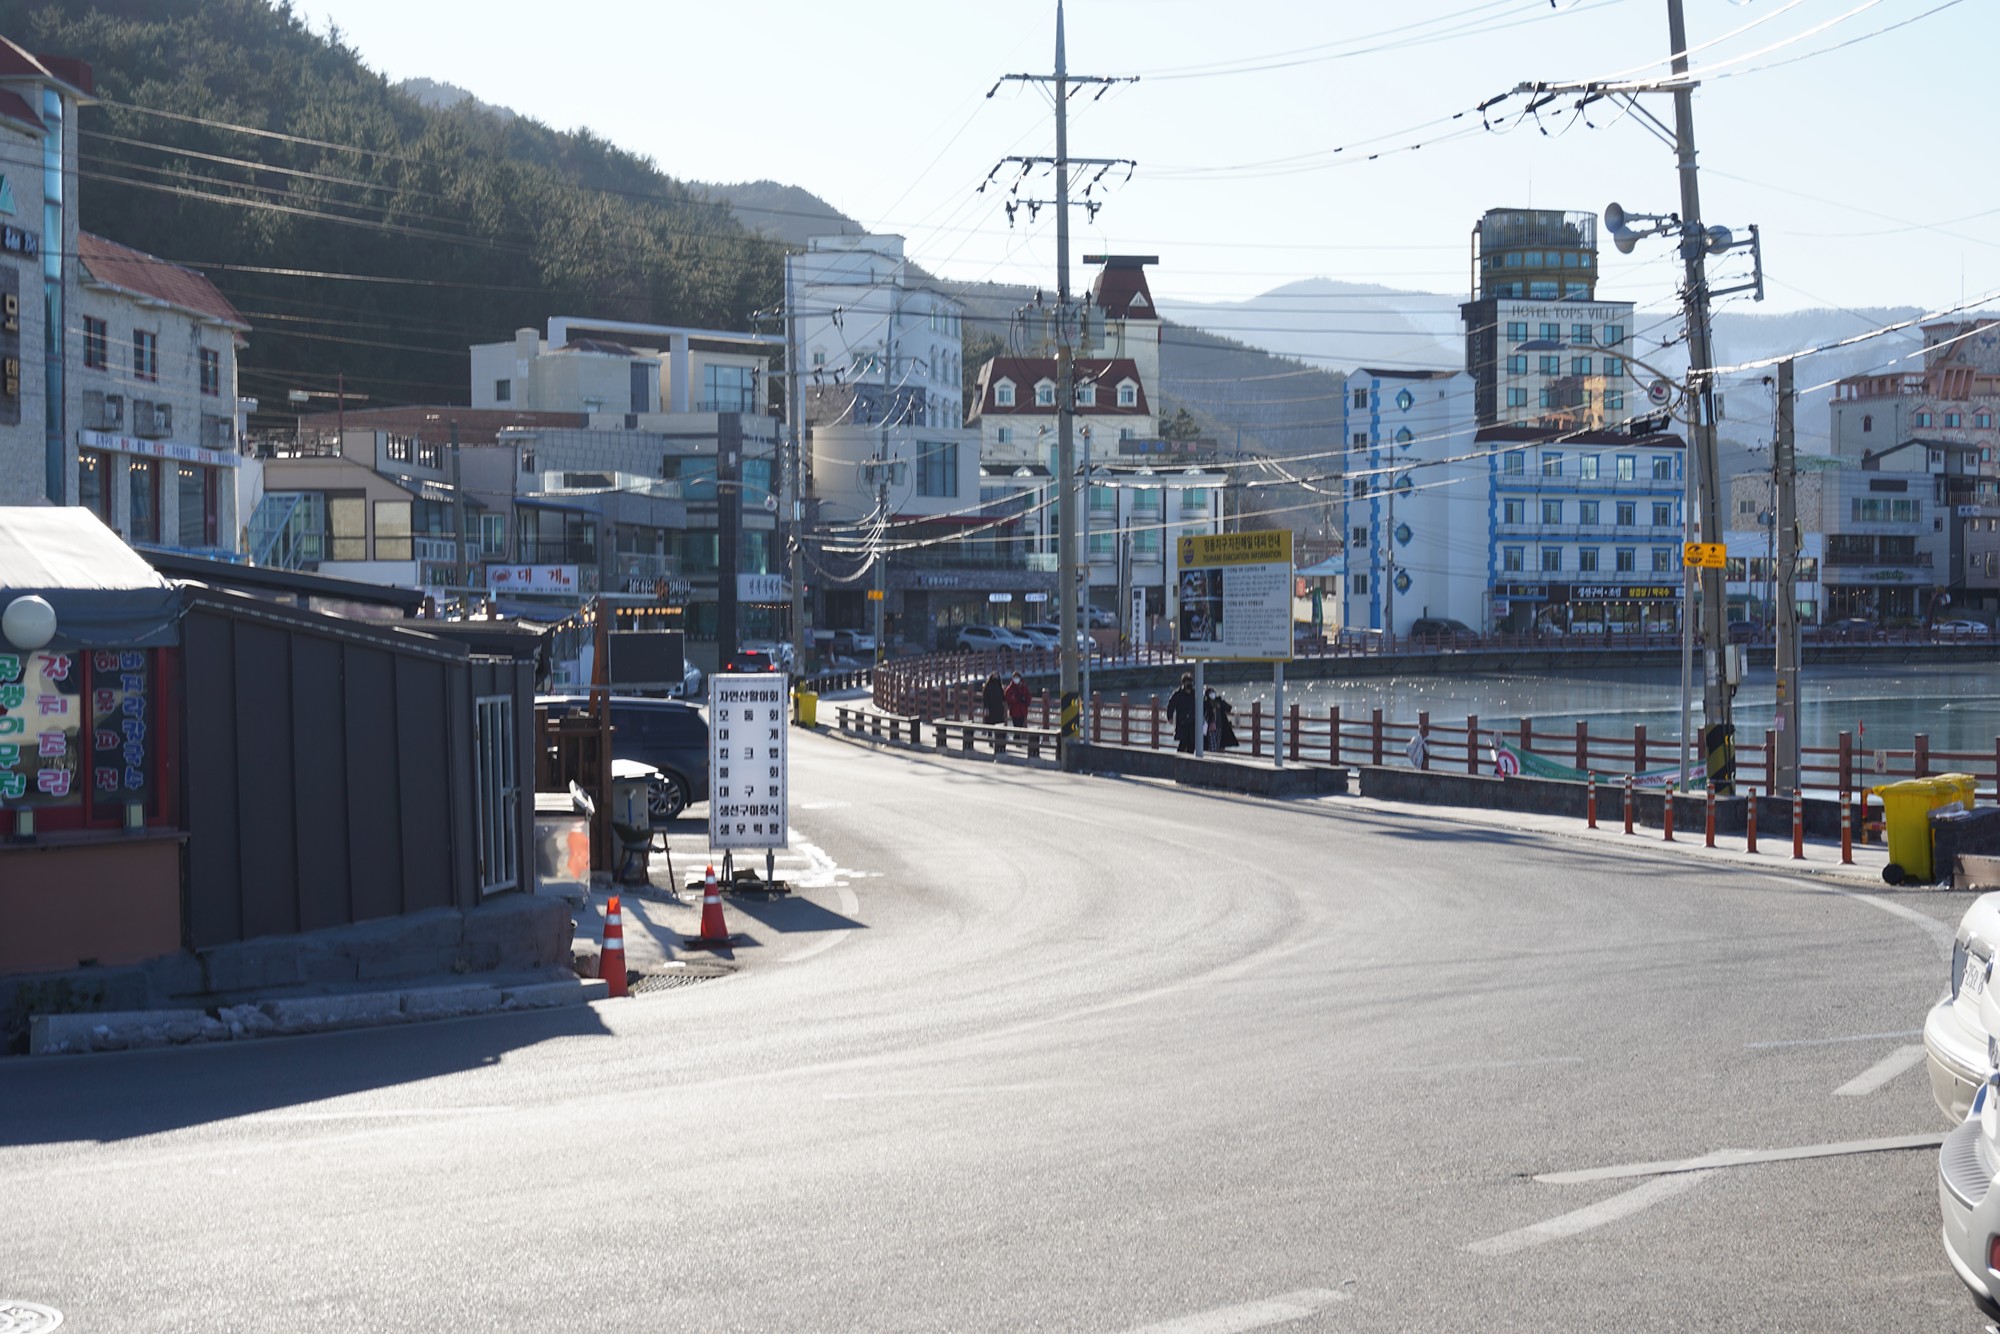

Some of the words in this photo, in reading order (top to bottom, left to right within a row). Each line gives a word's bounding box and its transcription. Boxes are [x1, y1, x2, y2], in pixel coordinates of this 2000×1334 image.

[1512, 305, 1546, 318] HOTEL
[1554, 307, 1583, 319] TOPS
[5, 293, 18, 396] 모텔
[1228, 535, 1252, 551] 지진해일
[1254, 534, 1266, 549] 대피
[1268, 533, 1280, 547] 안내
[1203, 553, 1222, 562] TSUNAMI
[1223, 552, 1249, 561] EVACUATION
[1251, 551, 1281, 560] INFORMATION
[719, 690, 779, 702] 자연산활어회
[719, 804, 779, 817] 생선구이정식
